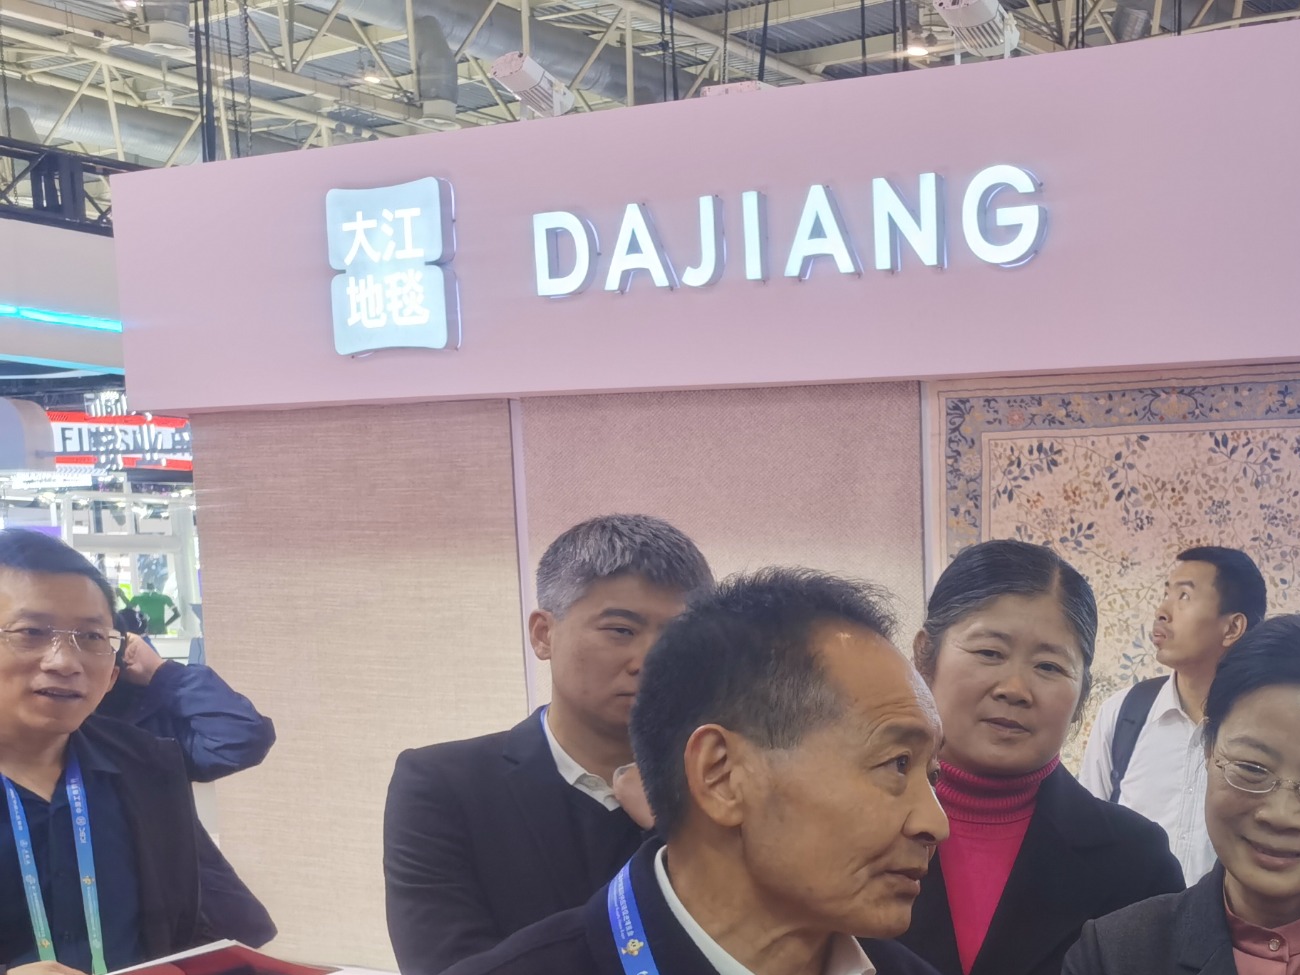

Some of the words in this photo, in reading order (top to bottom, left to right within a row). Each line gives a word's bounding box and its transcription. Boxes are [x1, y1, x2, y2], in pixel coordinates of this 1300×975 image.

[342, 207, 424, 266] 大江
[533, 164, 1041, 297] DAJIANG
[346, 268, 430, 329] 地毯
